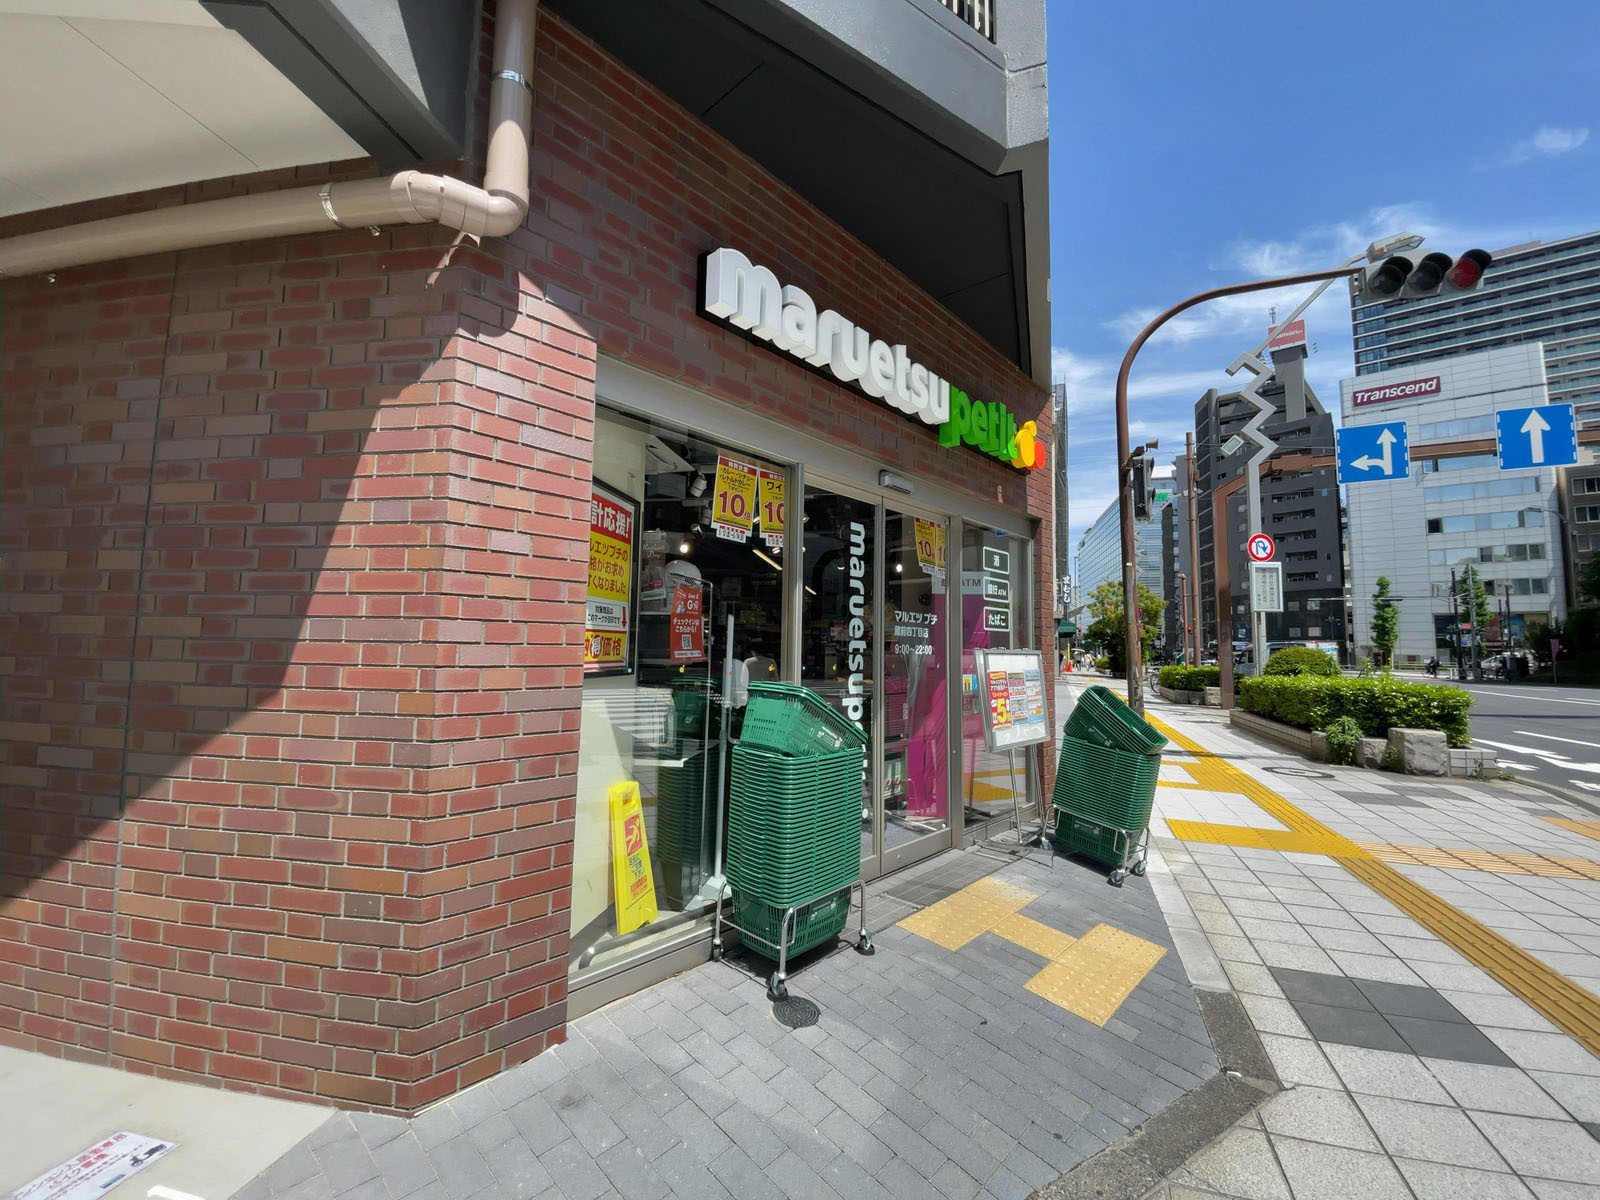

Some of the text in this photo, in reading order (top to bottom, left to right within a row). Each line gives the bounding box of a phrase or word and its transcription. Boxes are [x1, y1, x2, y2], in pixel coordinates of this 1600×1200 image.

[1355, 379, 1437, 403] Transcend
[988, 614, 1006, 626] たばこ
